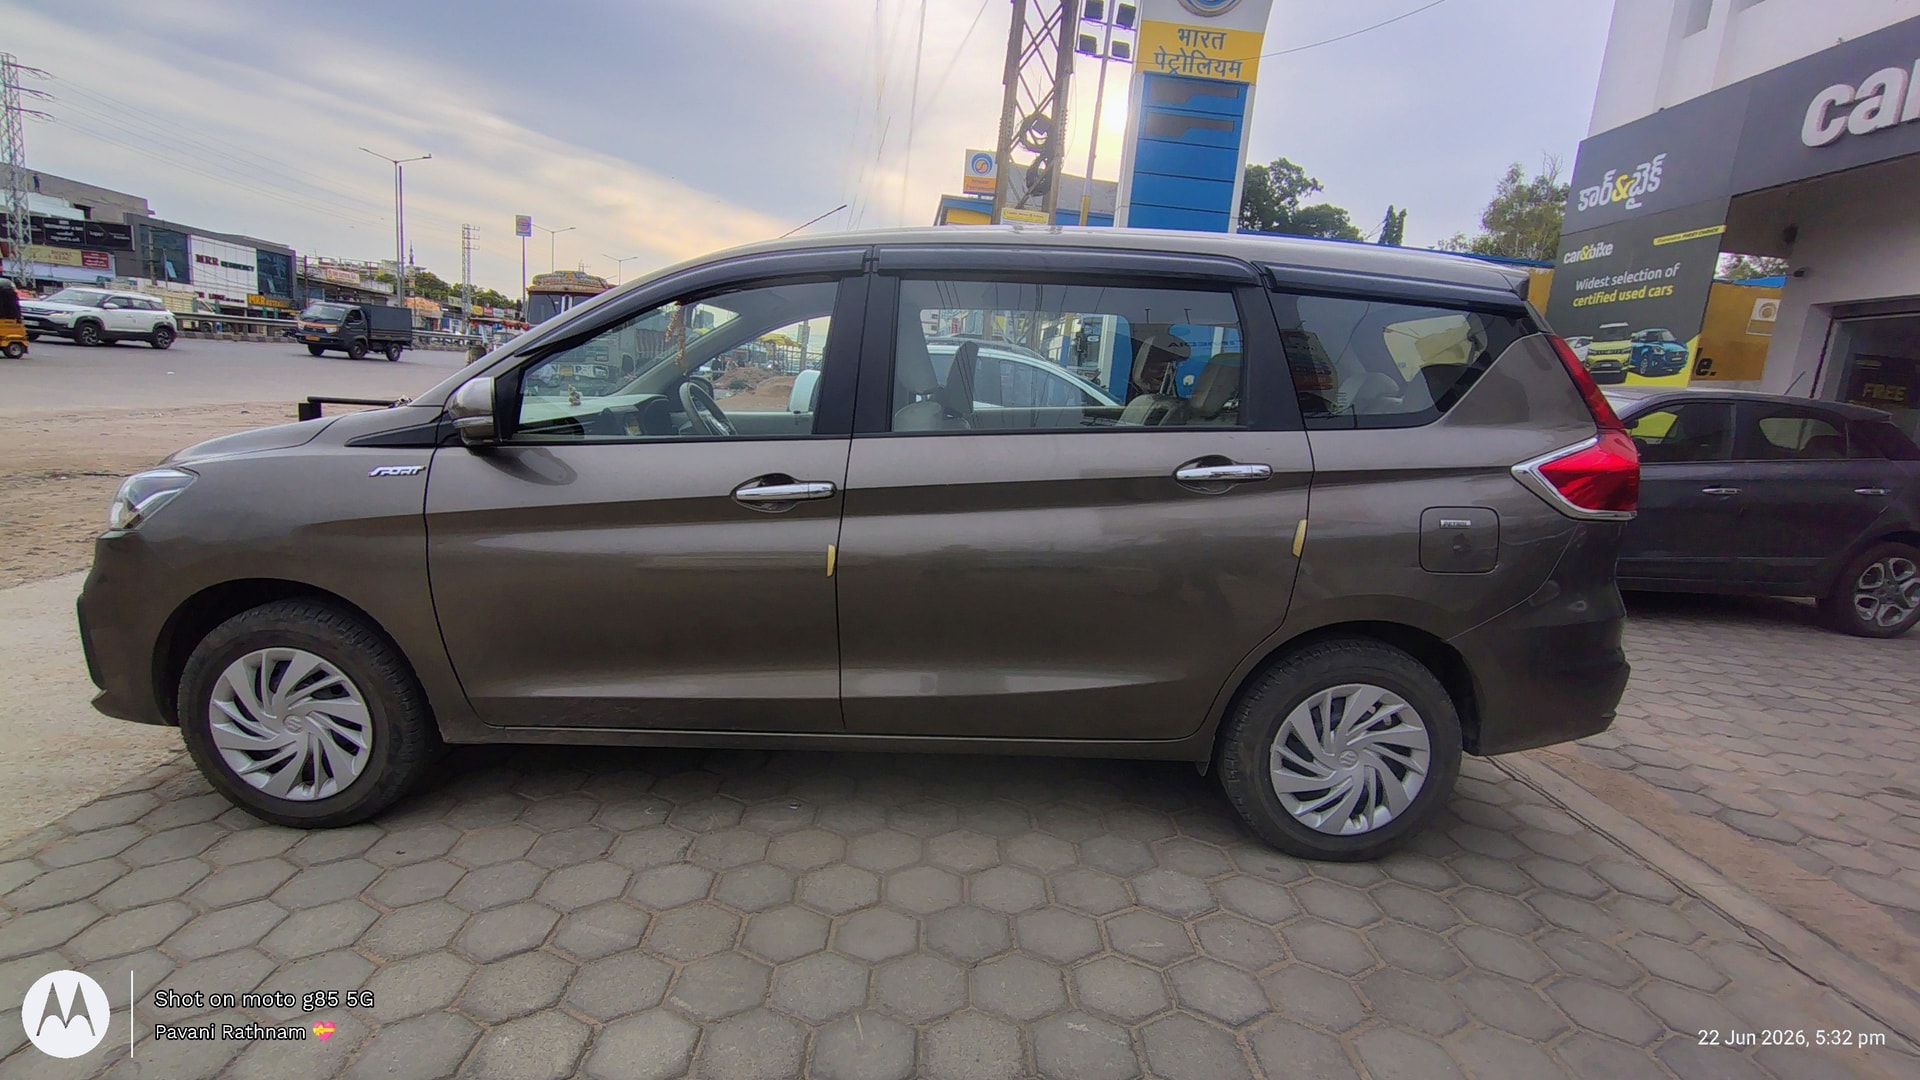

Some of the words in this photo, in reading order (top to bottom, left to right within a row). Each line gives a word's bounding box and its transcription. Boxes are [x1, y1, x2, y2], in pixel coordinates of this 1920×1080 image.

[1178, 28, 1226, 50] भारत
[1153, 45, 1243, 78] पेट्रोलियम
[1563, 241, 1614, 264] car&bike
[1576, 276, 1611, 291] Widest
[1611, 268, 1662, 286] selection
[1664, 262, 1681, 278] of
[1573, 289, 1618, 307] certified
[1619, 285, 1646, 301] used
[1648, 284, 1674, 298] cars
[1863, 383, 1907, 401] FREE
[368, 465, 426, 477] SPORT
